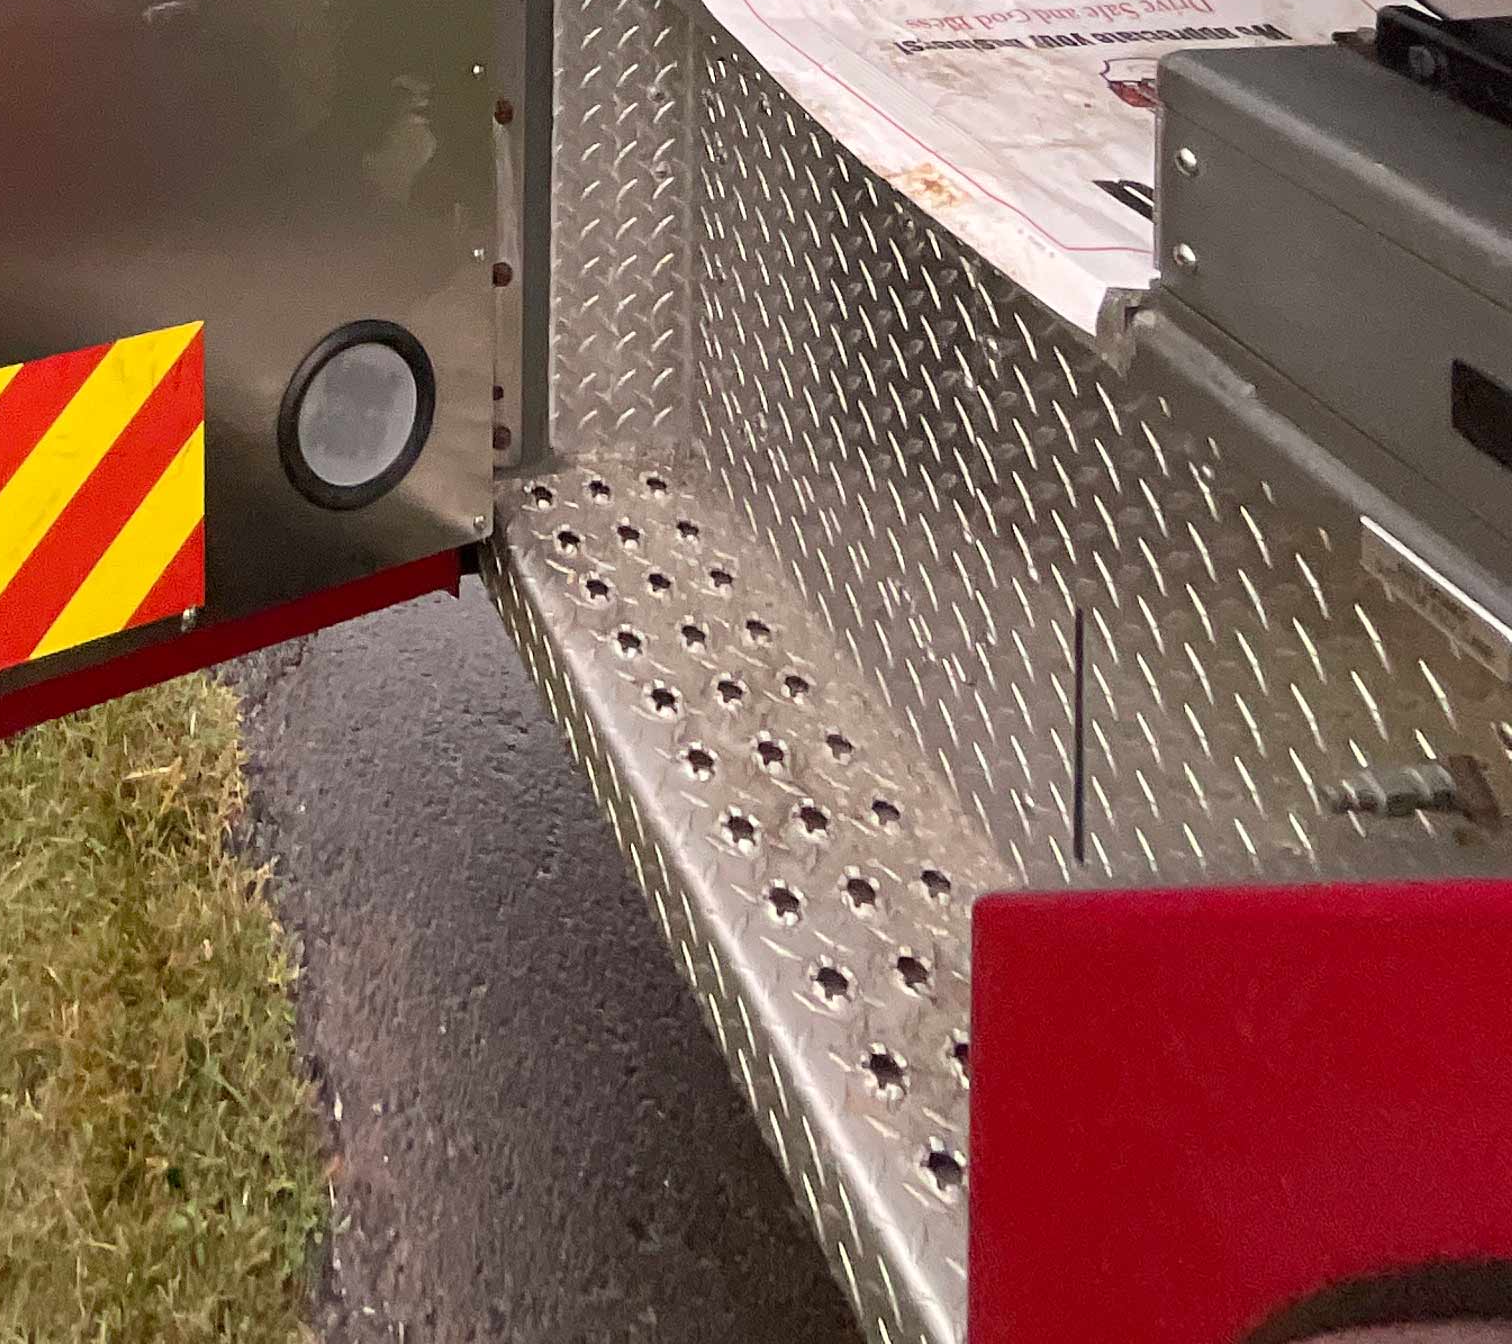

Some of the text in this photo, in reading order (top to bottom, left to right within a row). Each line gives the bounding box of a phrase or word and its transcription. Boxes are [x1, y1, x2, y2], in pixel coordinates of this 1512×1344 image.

[974, 8, 1032, 30] God
[1033, 9, 1079, 24] and
[1088, 2, 1141, 22] Safe
[905, 15, 974, 32] Bless
[1235, 23, 1293, 41] We
[1029, 32, 1096, 49] your
[1091, 26, 1240, 44] appreciate
